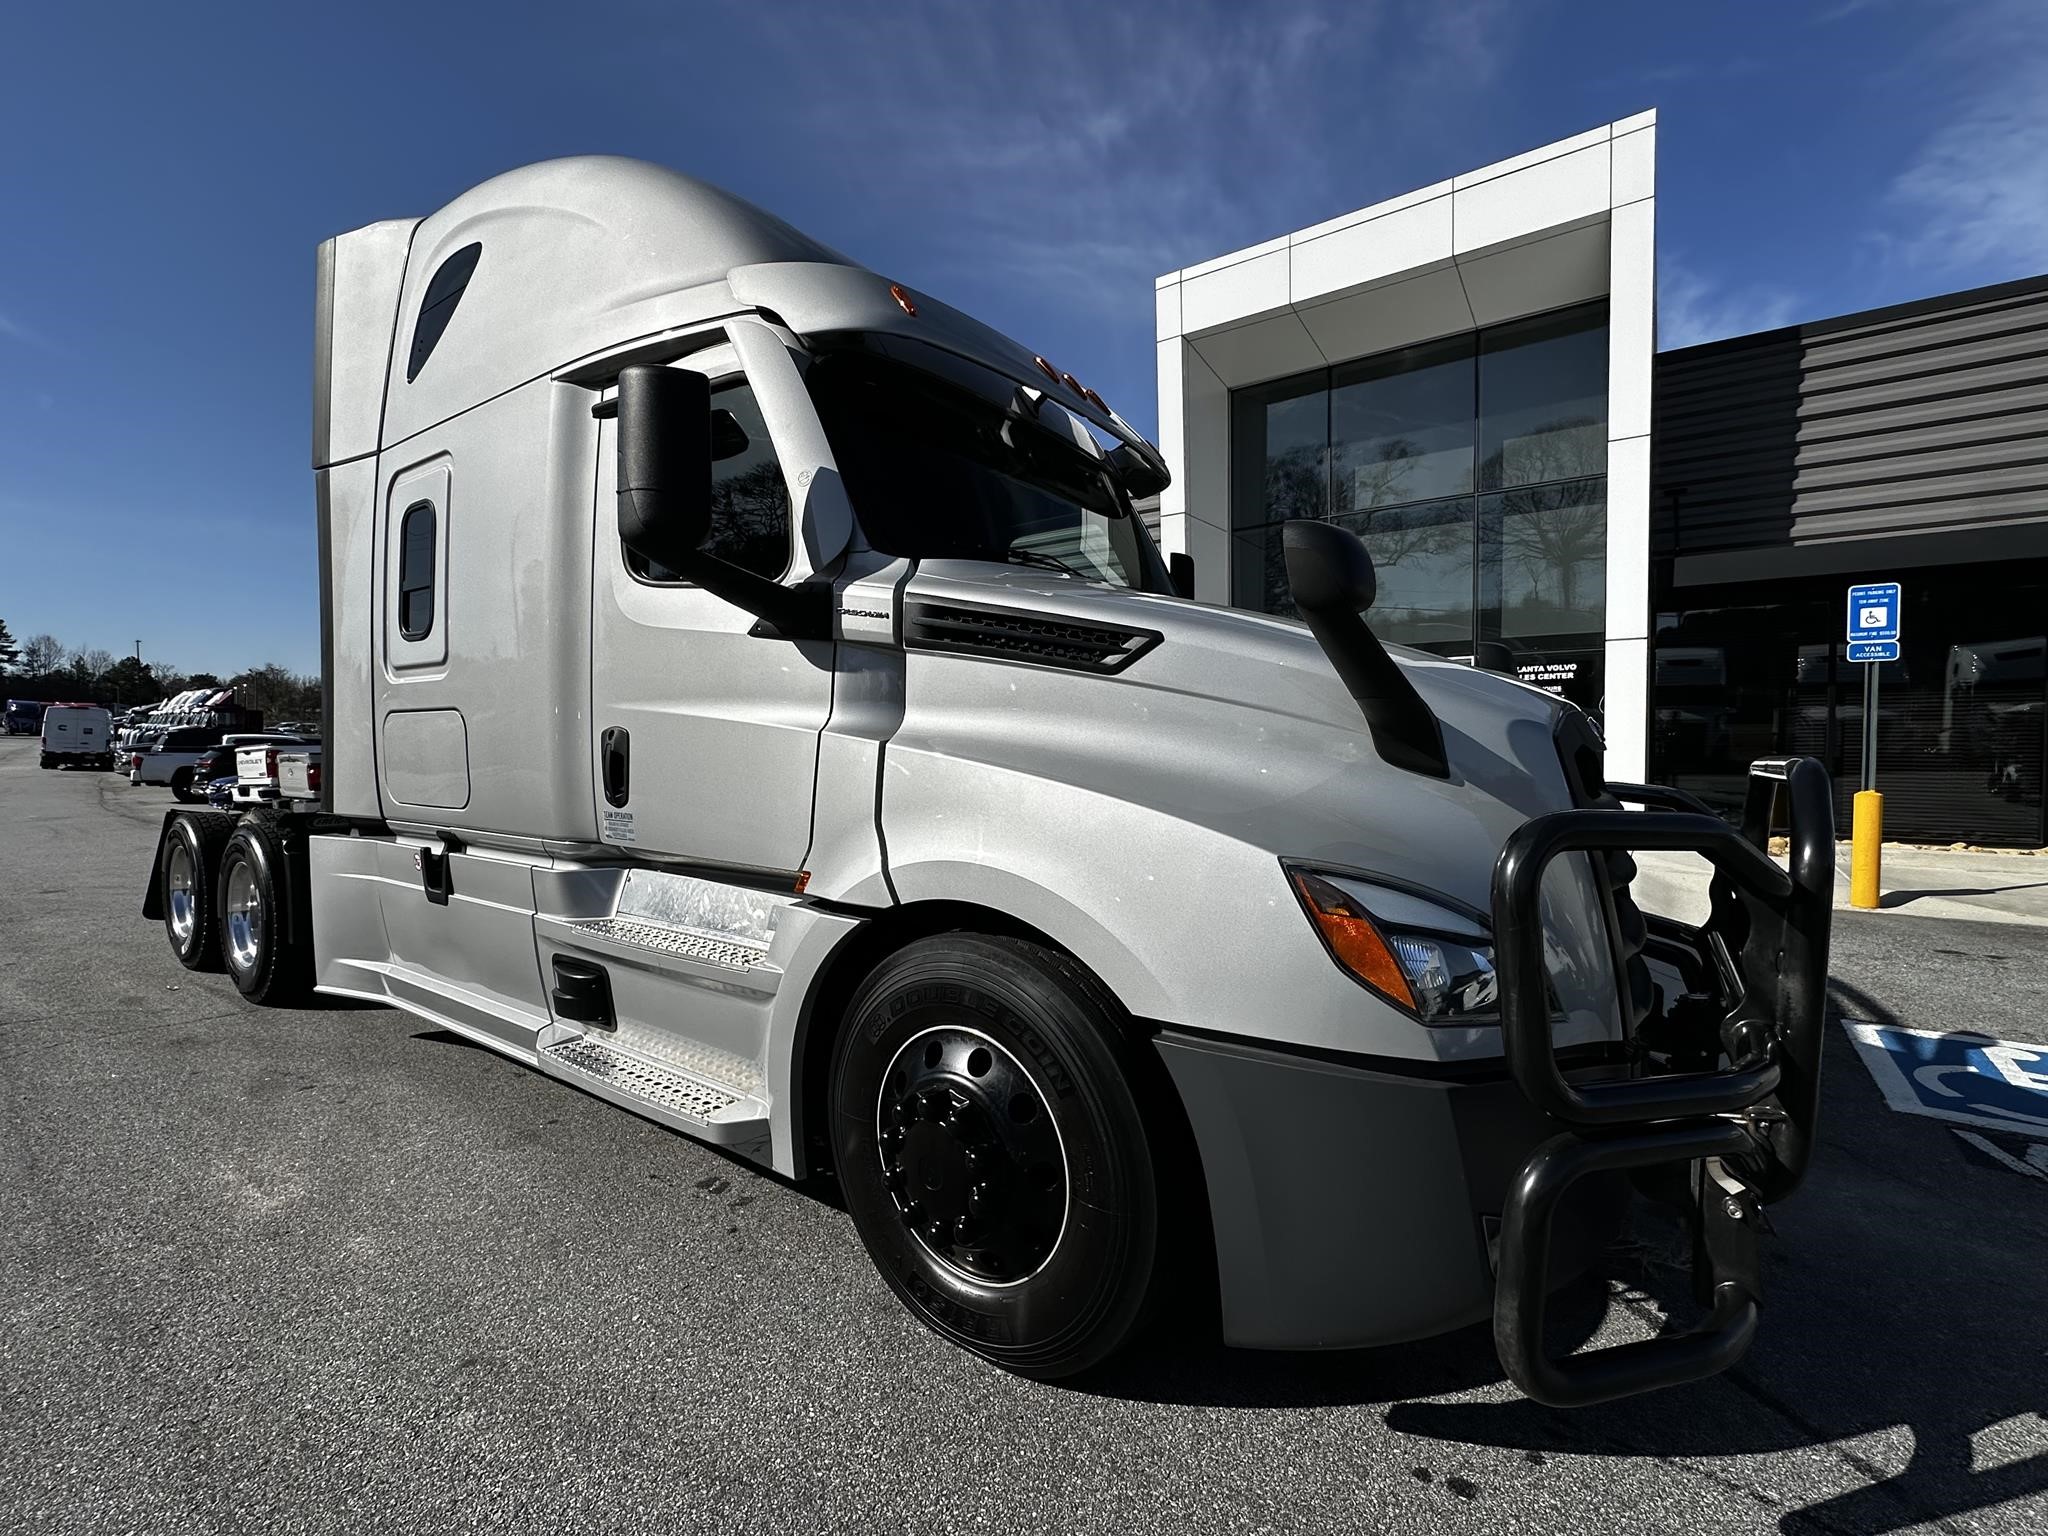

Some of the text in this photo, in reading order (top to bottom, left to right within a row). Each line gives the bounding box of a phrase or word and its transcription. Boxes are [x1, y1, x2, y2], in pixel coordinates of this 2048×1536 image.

[1546, 663, 1577, 672] VOLVO
[1537, 672, 1574, 680] CENTER
[889, 985, 1074, 1094] DOUBLE COIN
